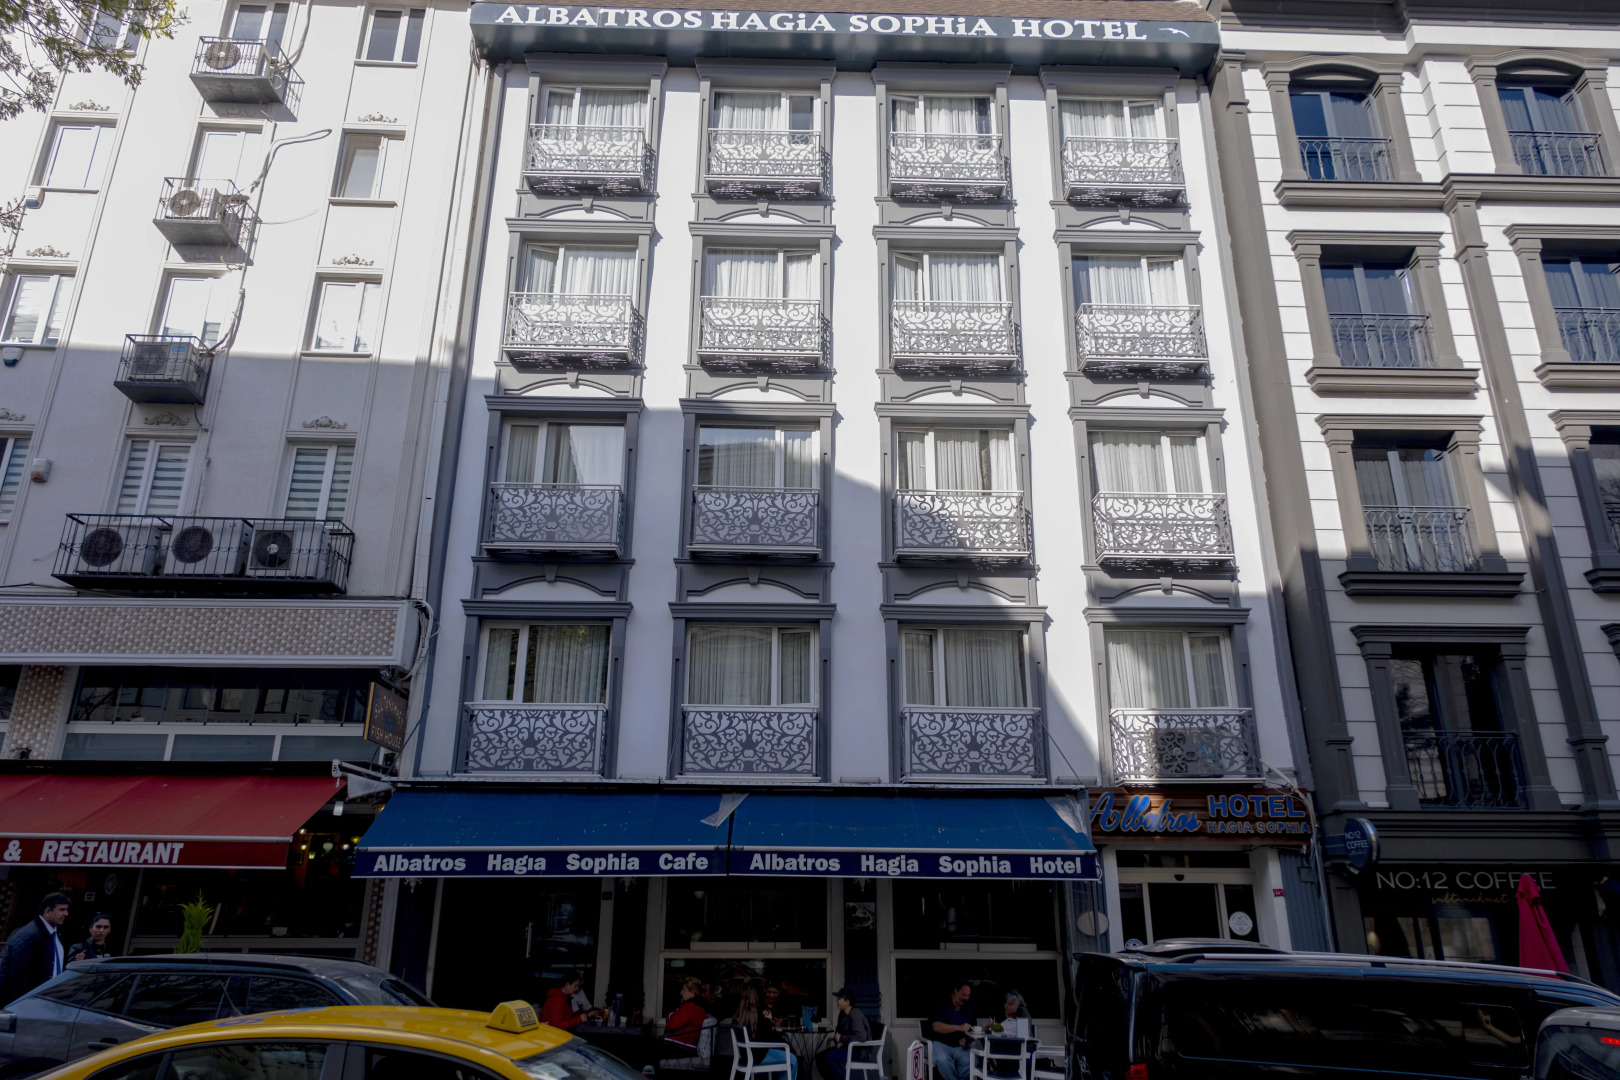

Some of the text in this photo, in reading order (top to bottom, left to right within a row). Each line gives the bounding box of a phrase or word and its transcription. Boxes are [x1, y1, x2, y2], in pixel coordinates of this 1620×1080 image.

[495, 6, 703, 29] ALBATROS
[1012, 19, 1148, 41] HOTEL
[371, 726, 402, 749] FISH HOUSE
[1090, 792, 1306, 833] Albatros HOTEL
[1207, 820, 1311, 834] HAGIA SOPHIA
[3, 839, 185, 865] & RESTAURANT
[1346, 840, 1369, 850] COFFEE
[373, 854, 467, 873] Albatros
[566, 853, 640, 874] Sophia
[658, 852, 709, 871] Cafe
[750, 853, 1082, 877] Albatros Hagia Sophia Hotel
[1376, 871, 1449, 890] NO:12
